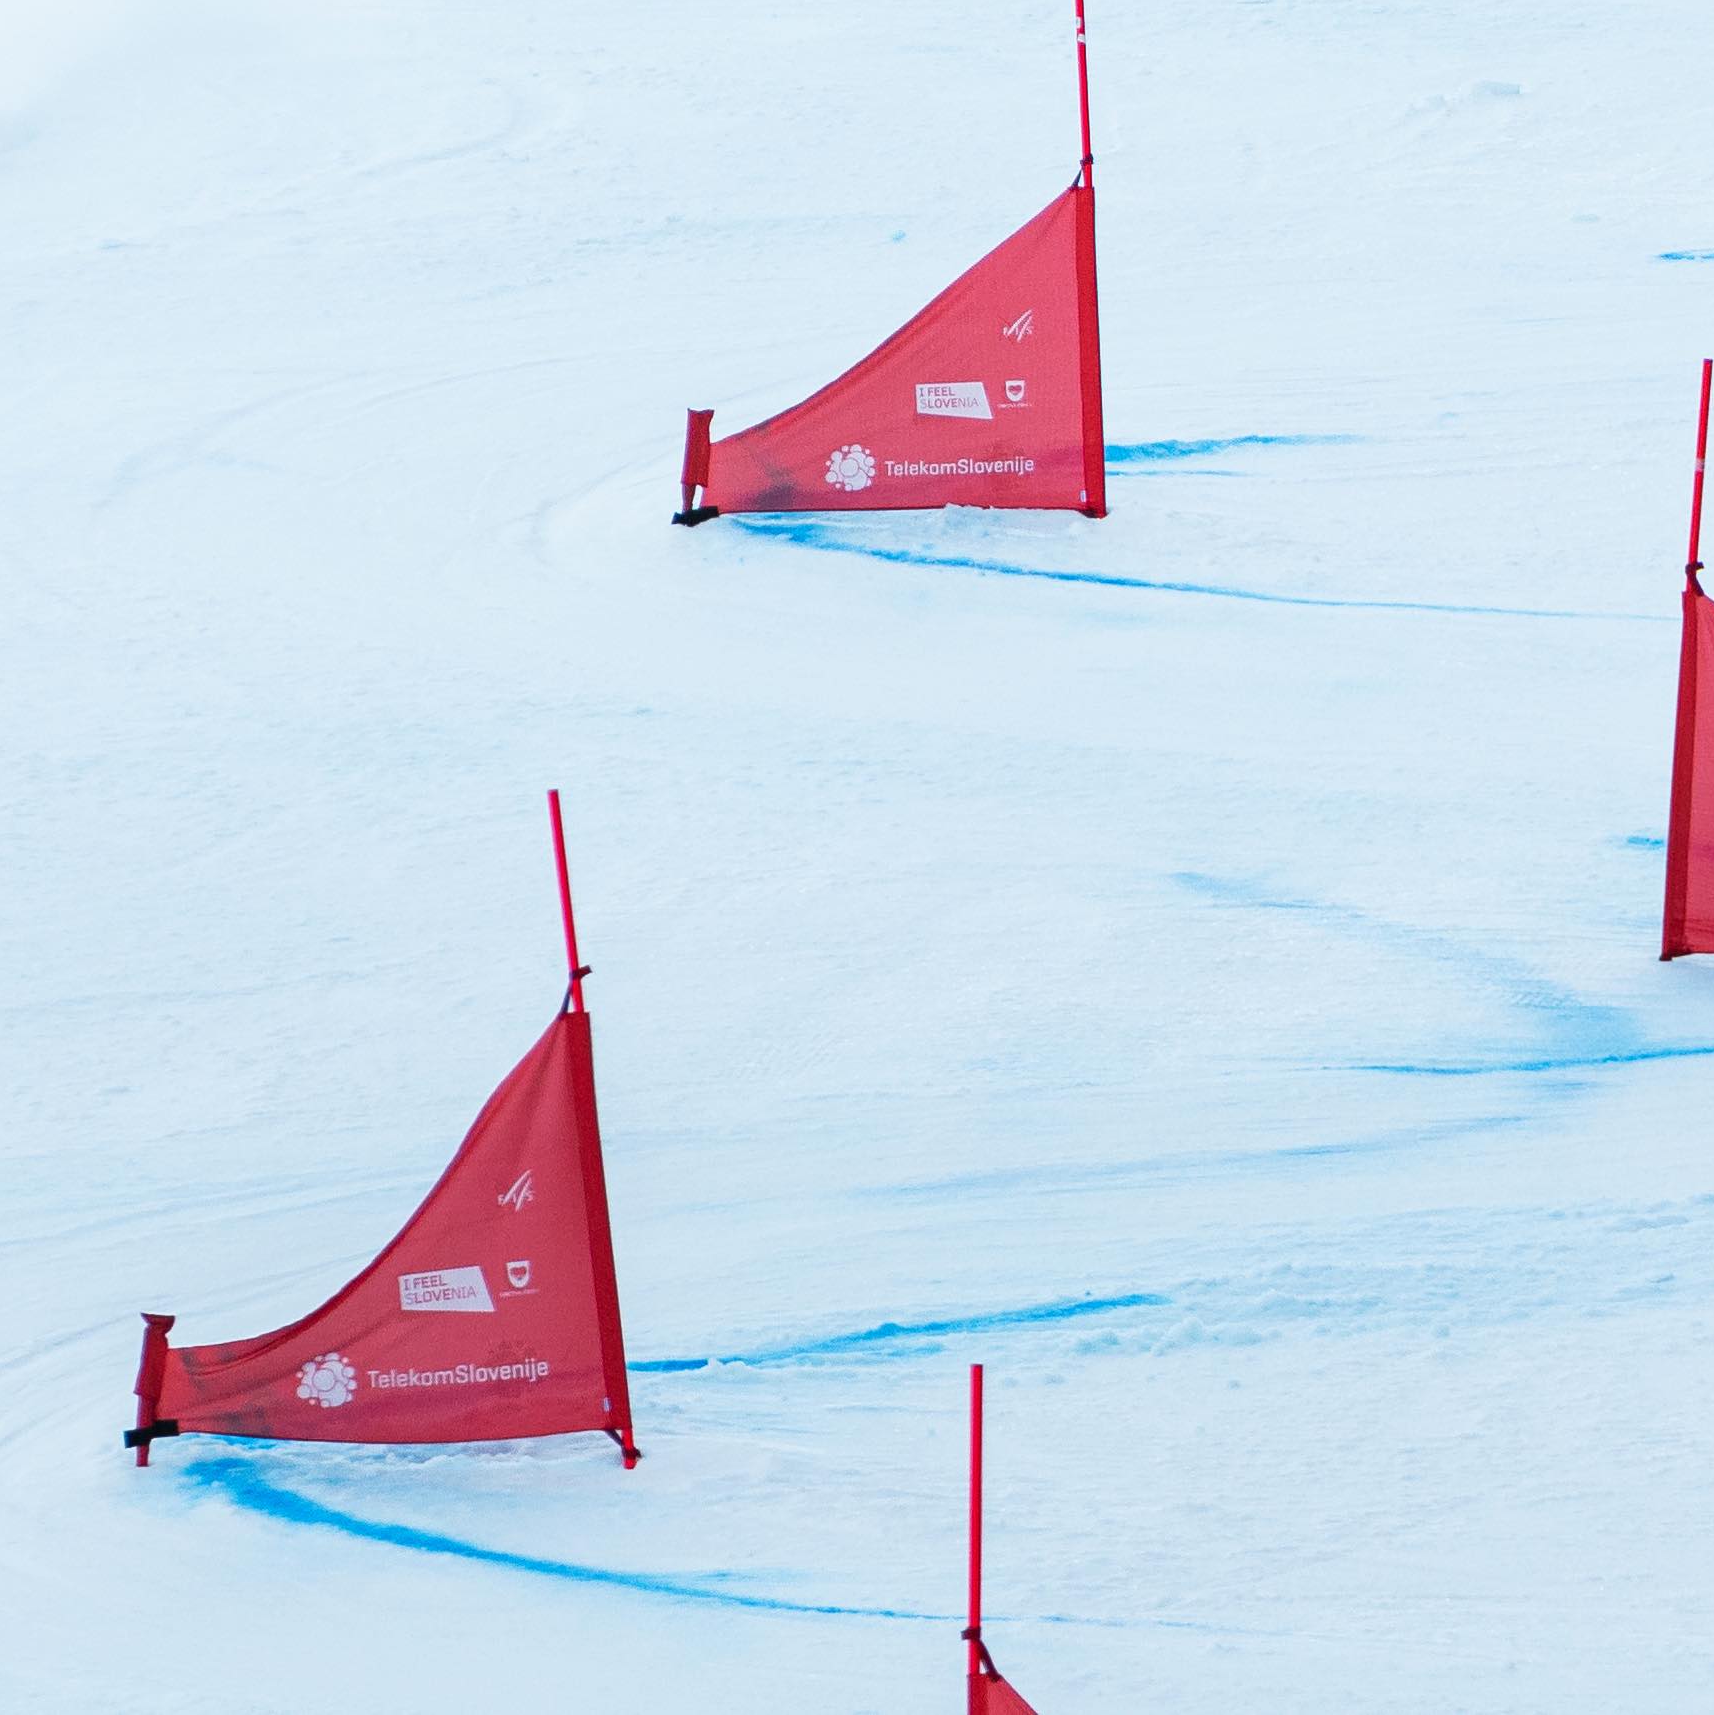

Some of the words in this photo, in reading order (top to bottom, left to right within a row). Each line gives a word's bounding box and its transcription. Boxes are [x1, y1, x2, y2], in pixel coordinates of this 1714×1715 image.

[919, 387, 925, 398] I
[927, 386, 956, 398] FEEL
[919, 396, 980, 409] SLOVENIA
[884, 457, 1035, 479] TelekomSlovenije
[403, 1277, 409, 1292] I
[413, 1274, 446, 1290] FEEL
[404, 1285, 478, 1306] SLOVENIA
[366, 1356, 551, 1389] TelekomSlovenije
